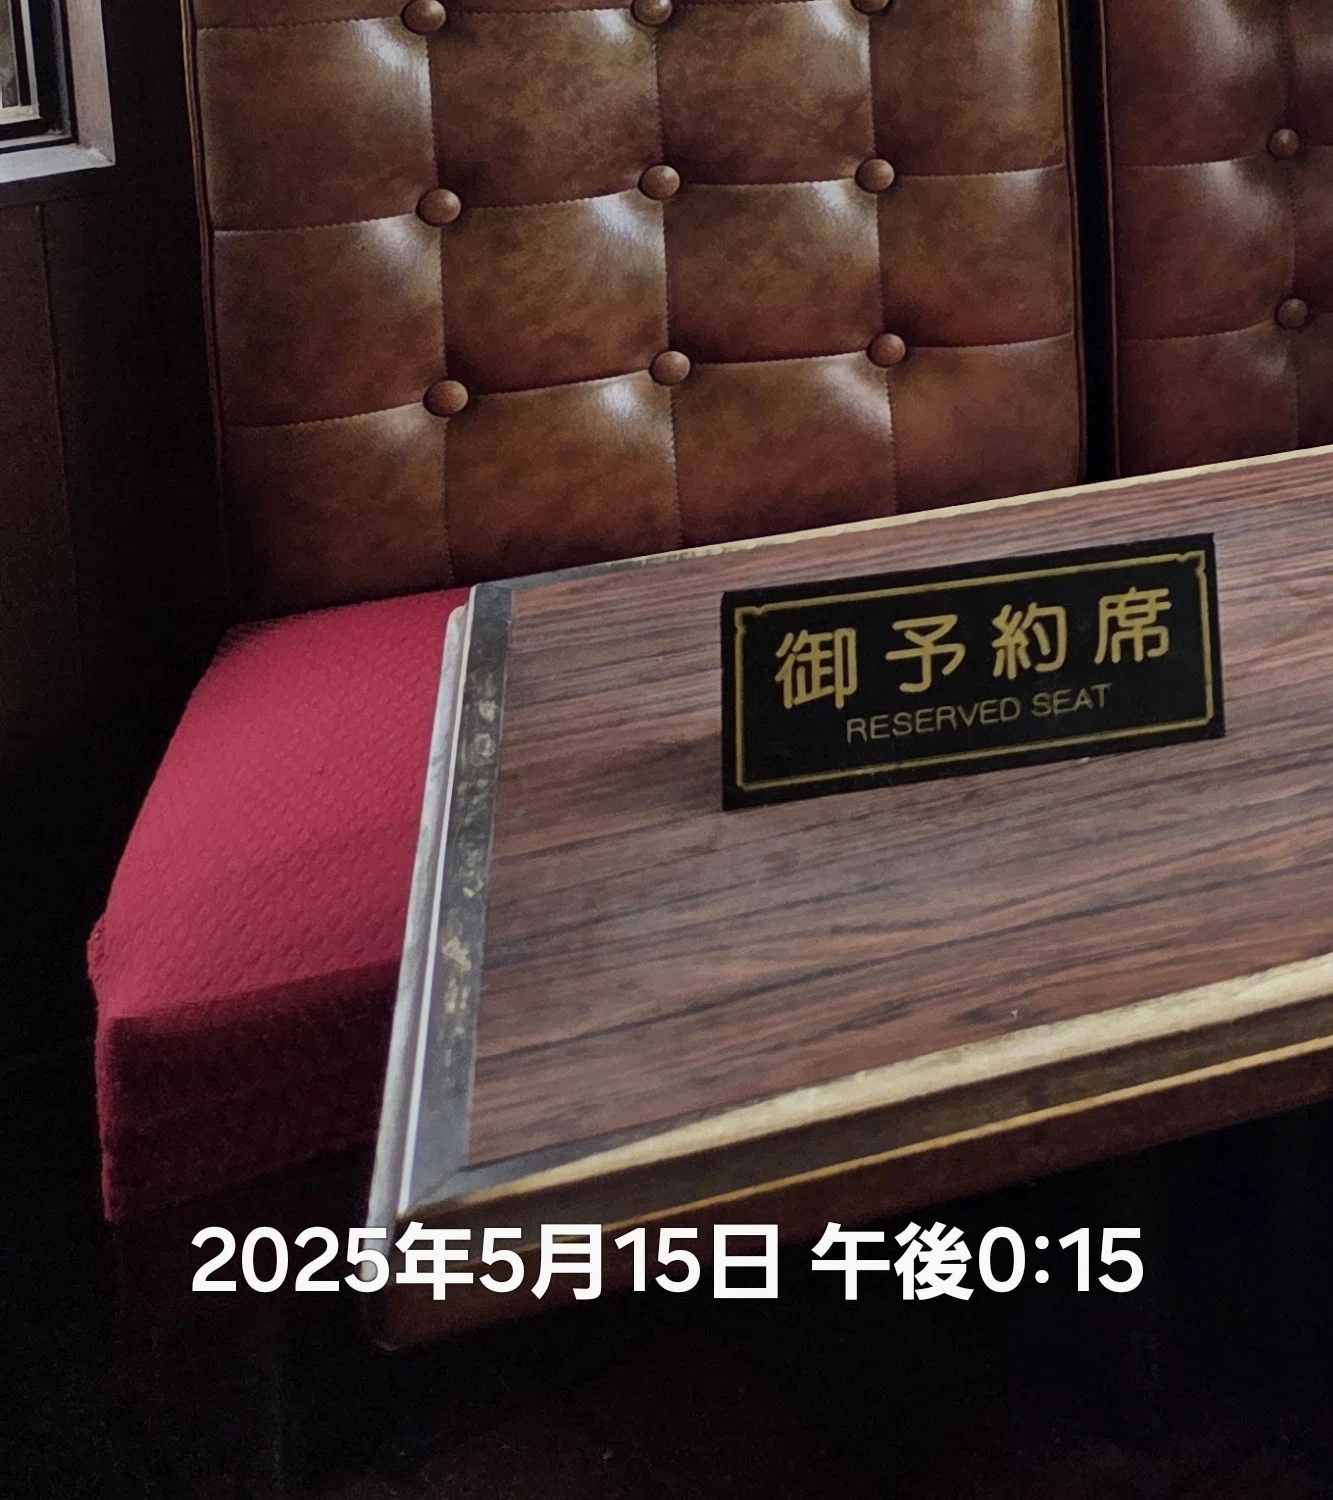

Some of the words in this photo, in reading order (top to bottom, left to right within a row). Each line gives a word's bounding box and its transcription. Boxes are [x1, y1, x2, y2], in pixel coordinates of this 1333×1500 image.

[774, 586, 1172, 710] 御予約席
[846, 696, 1021, 744] RESERVED
[1031, 683, 1113, 718] SEAT
